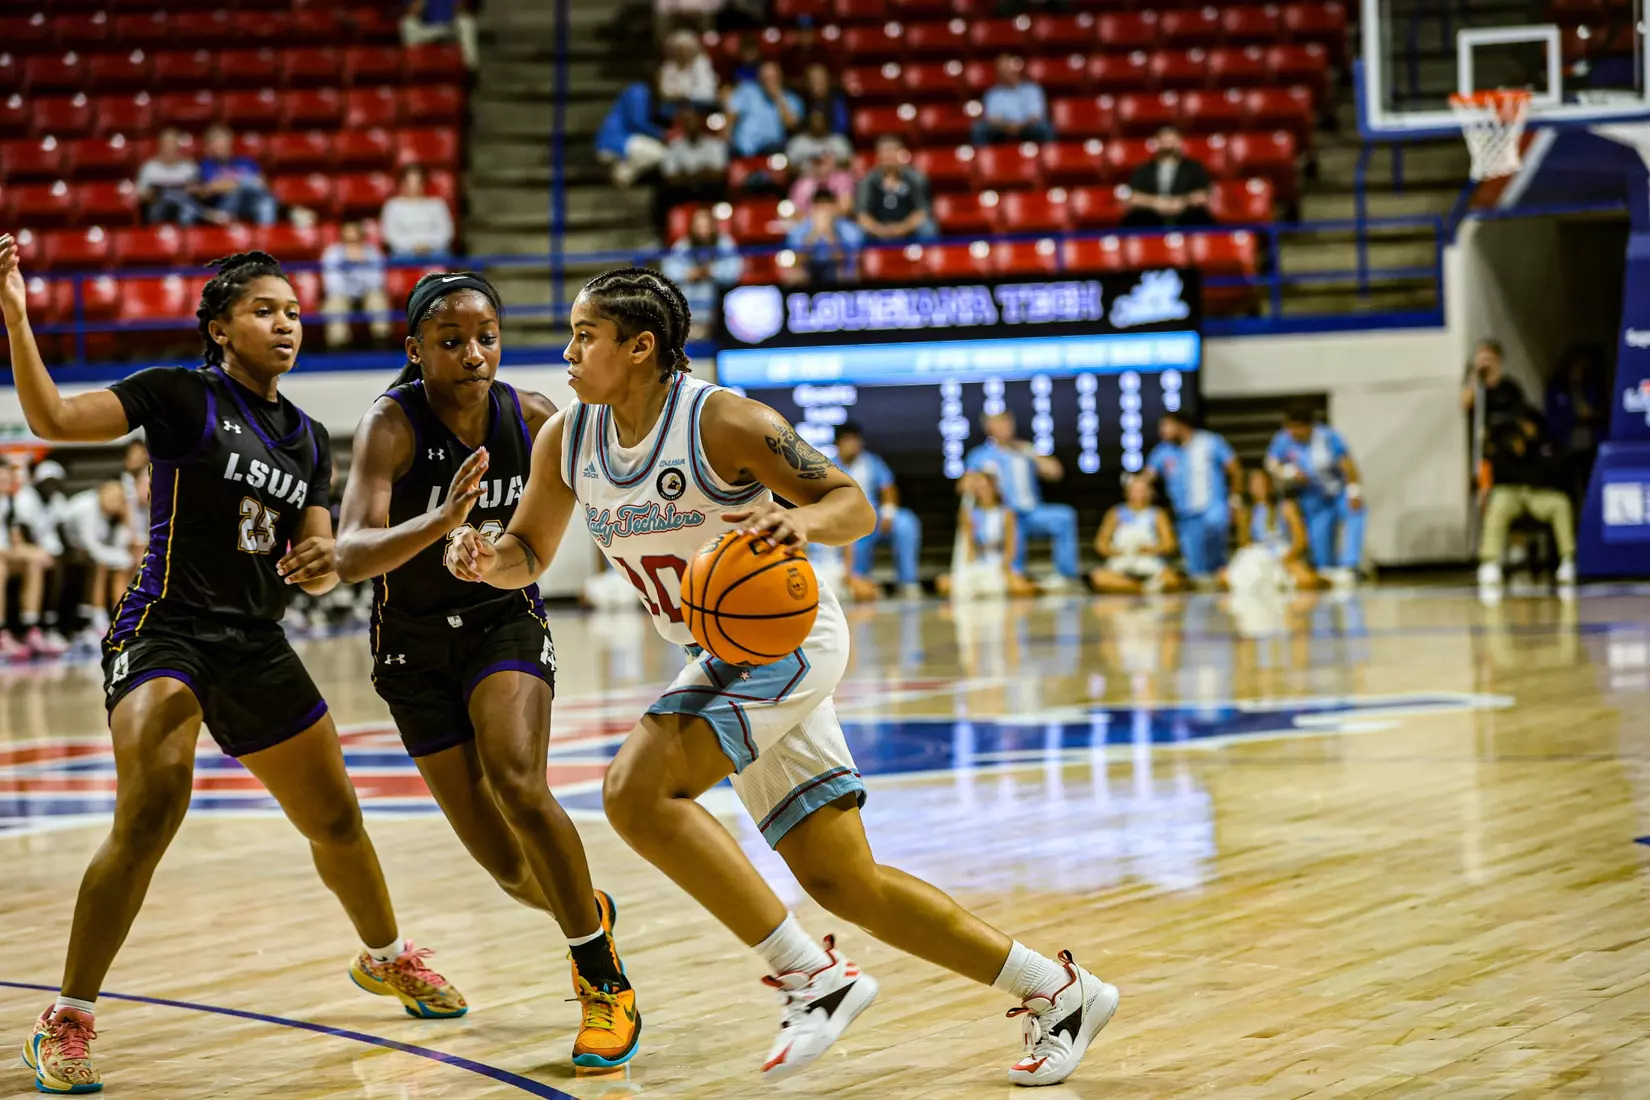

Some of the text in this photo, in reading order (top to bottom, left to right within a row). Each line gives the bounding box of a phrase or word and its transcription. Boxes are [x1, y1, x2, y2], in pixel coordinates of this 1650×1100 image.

[223, 452, 308, 510] LSUA
[426, 474, 526, 514] LUA
[237, 496, 280, 554] 25
[612, 501, 705, 537] Techsters
